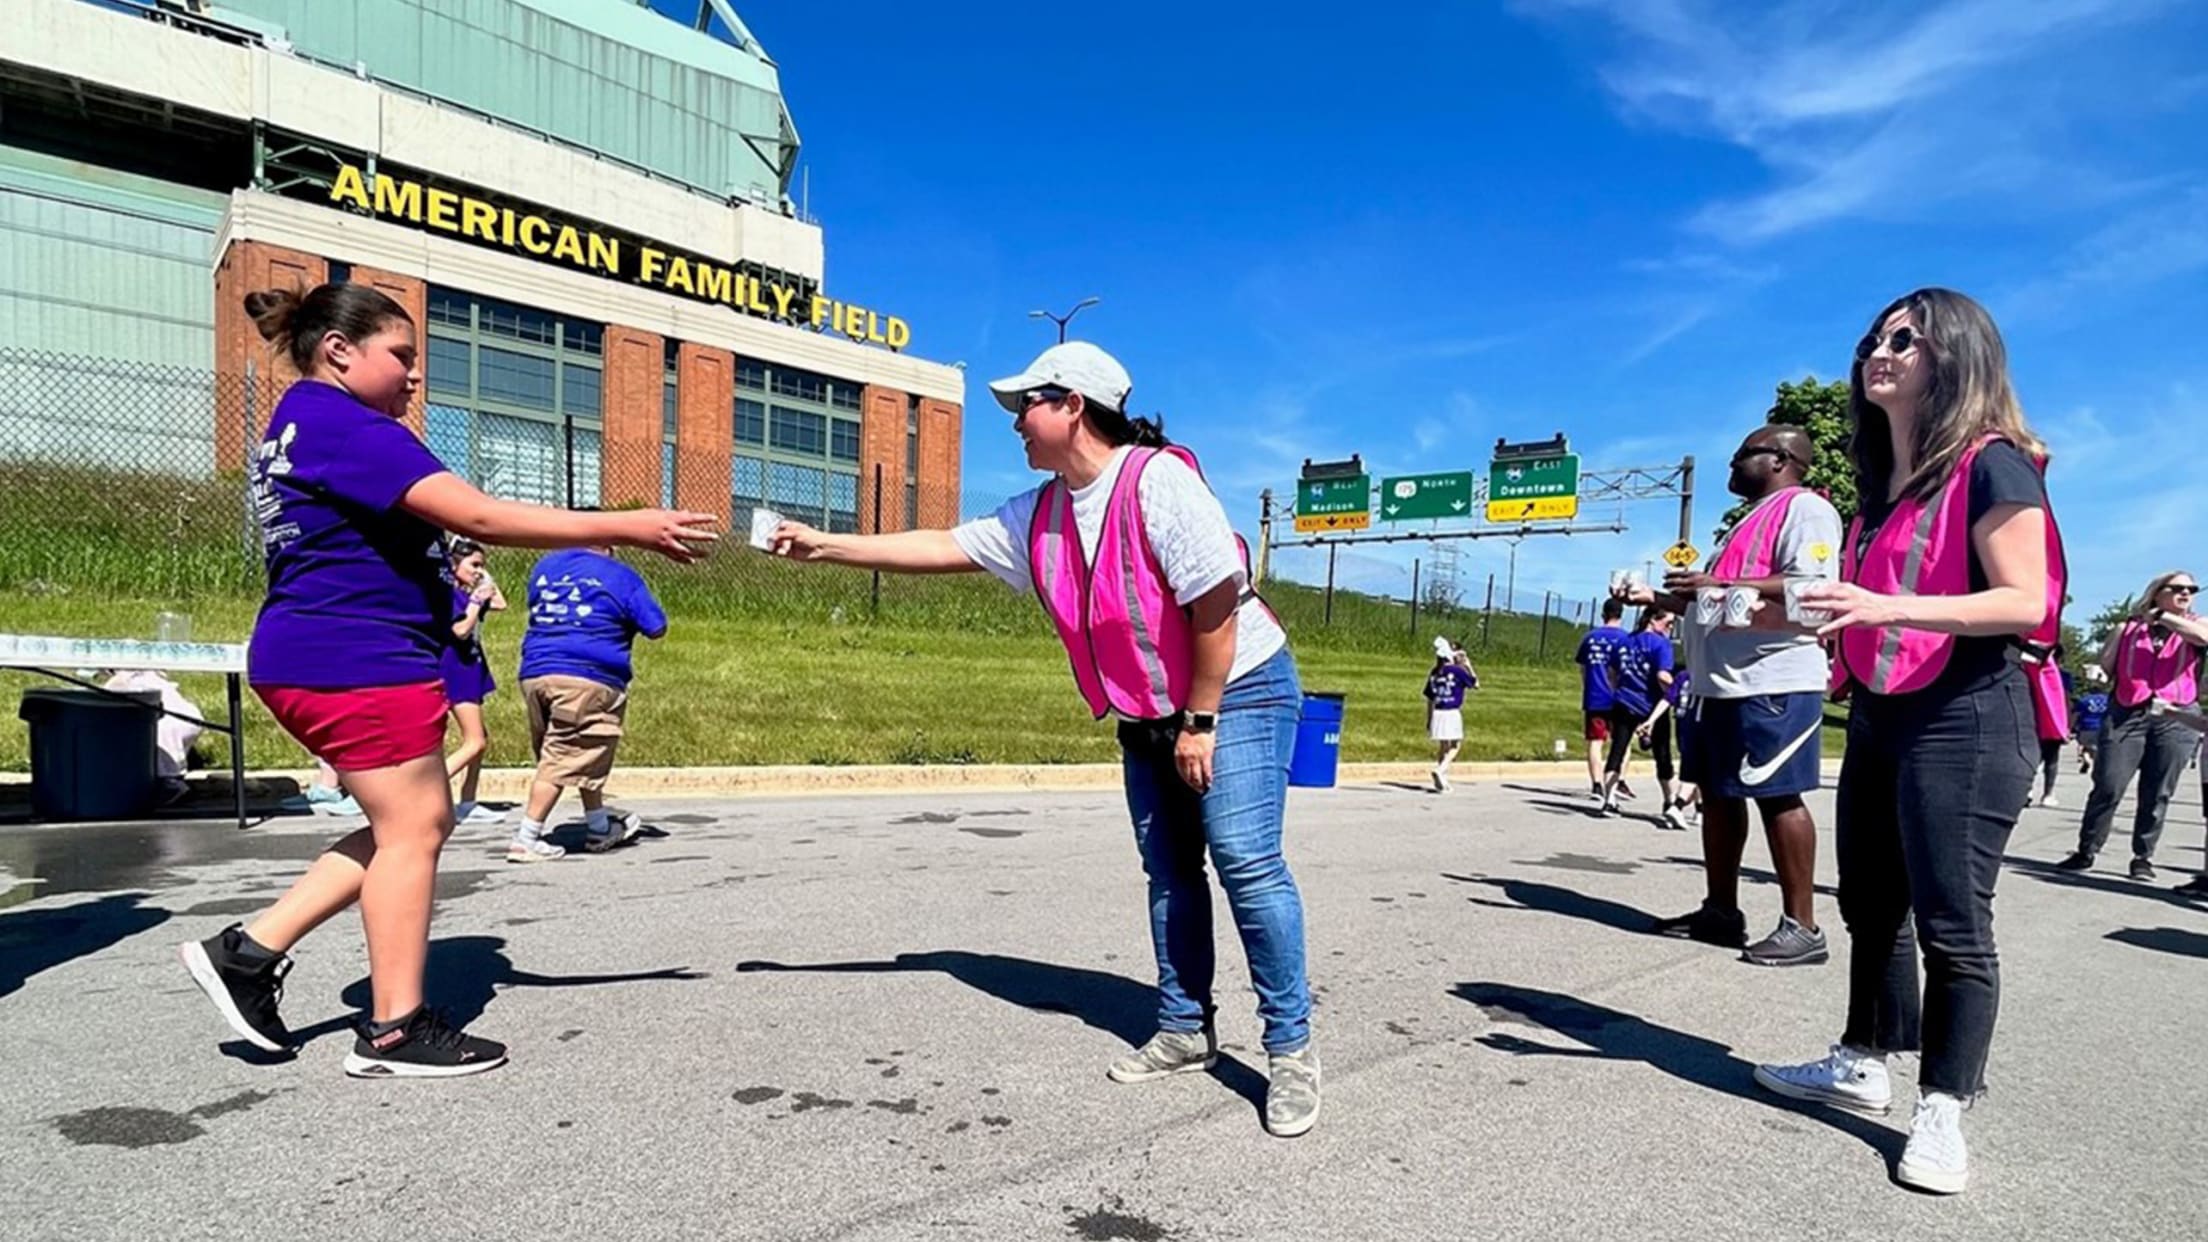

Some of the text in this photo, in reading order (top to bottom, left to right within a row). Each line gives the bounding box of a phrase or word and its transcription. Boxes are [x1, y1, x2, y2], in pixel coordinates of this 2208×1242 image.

[330, 163, 910, 348] AMERICAN FAMILY FIELD
[1533, 460, 1561, 471] EAST
[1500, 484, 1565, 496] Downtown
[1310, 502, 1355, 512] Madison
[1342, 516, 1367, 525] ONLY
